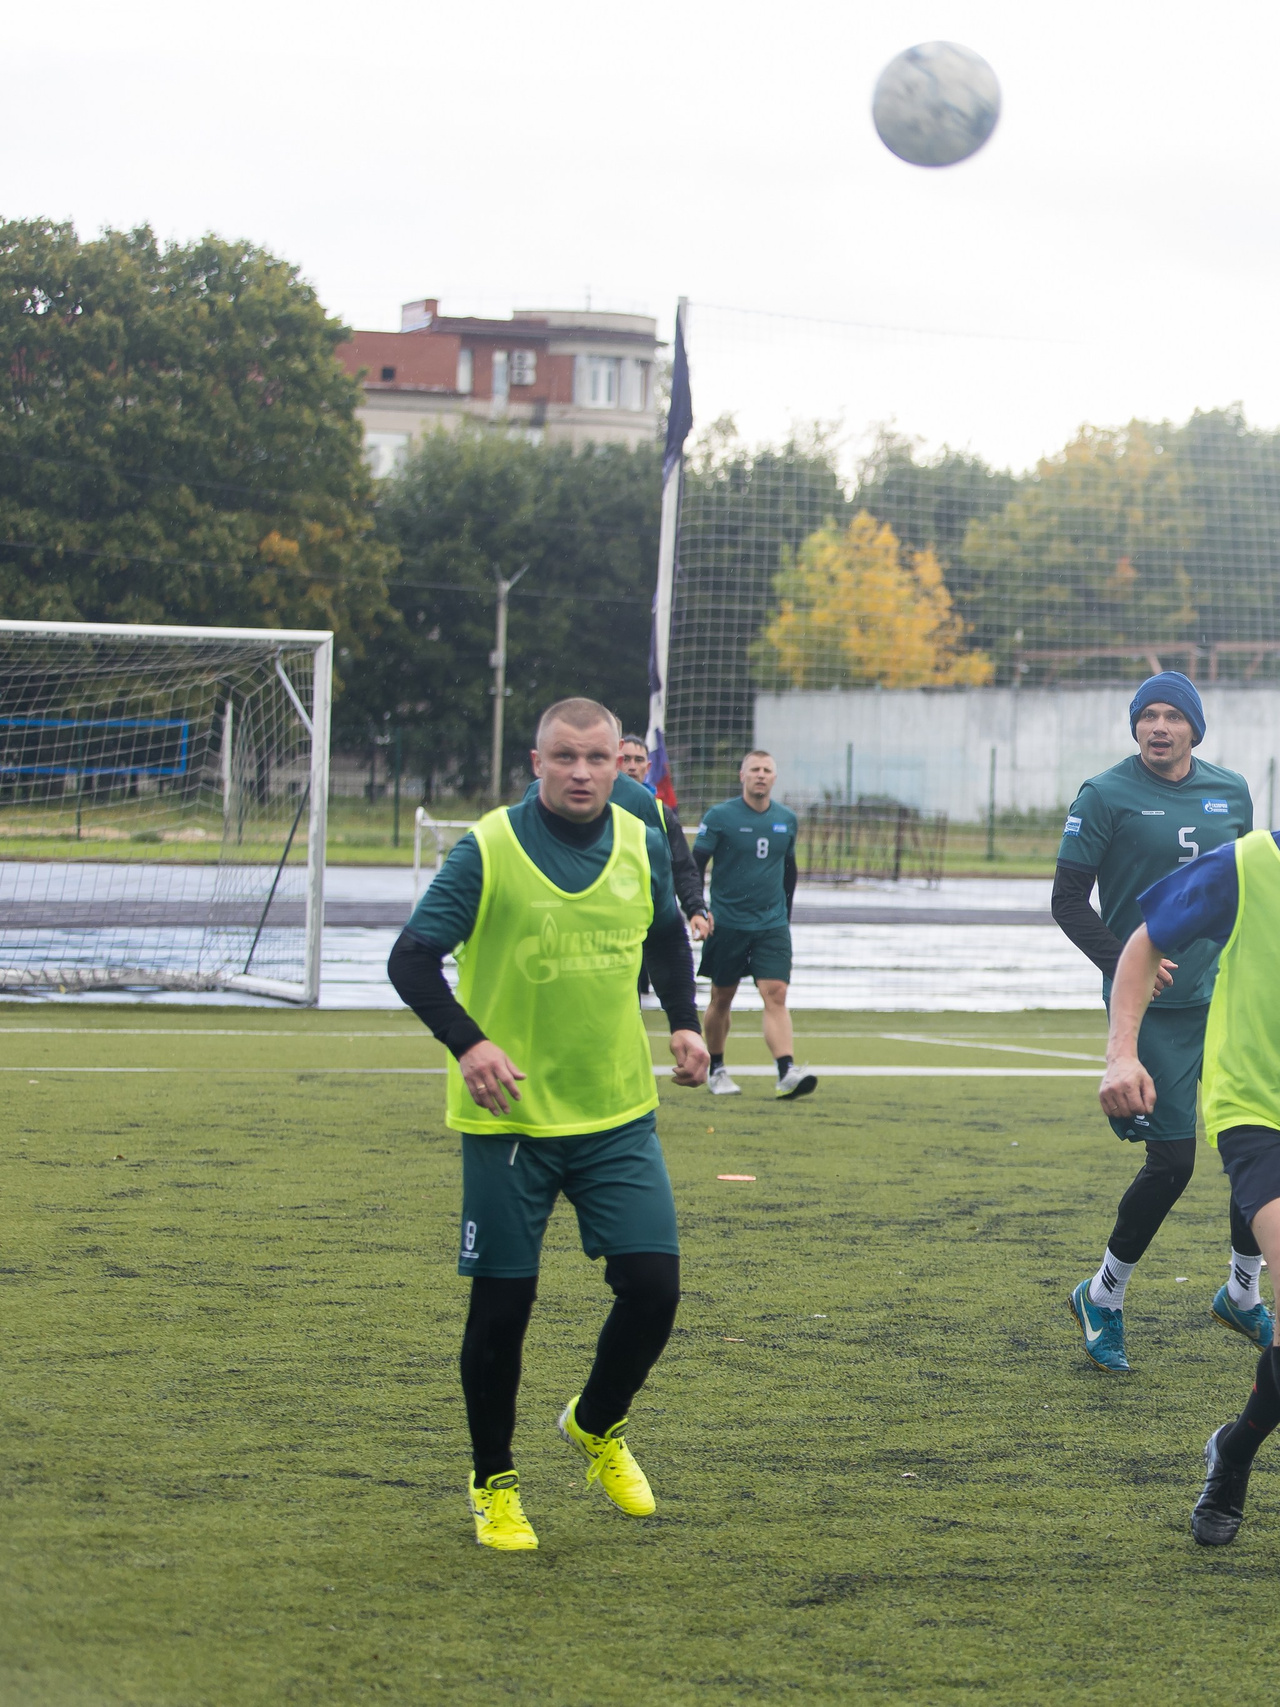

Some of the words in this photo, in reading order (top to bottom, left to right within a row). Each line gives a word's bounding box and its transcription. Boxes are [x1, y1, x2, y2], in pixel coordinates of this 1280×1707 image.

[756, 838, 769, 859] 8
[1177, 827, 1199, 863] 5
[466, 1221, 477, 1250] 8
